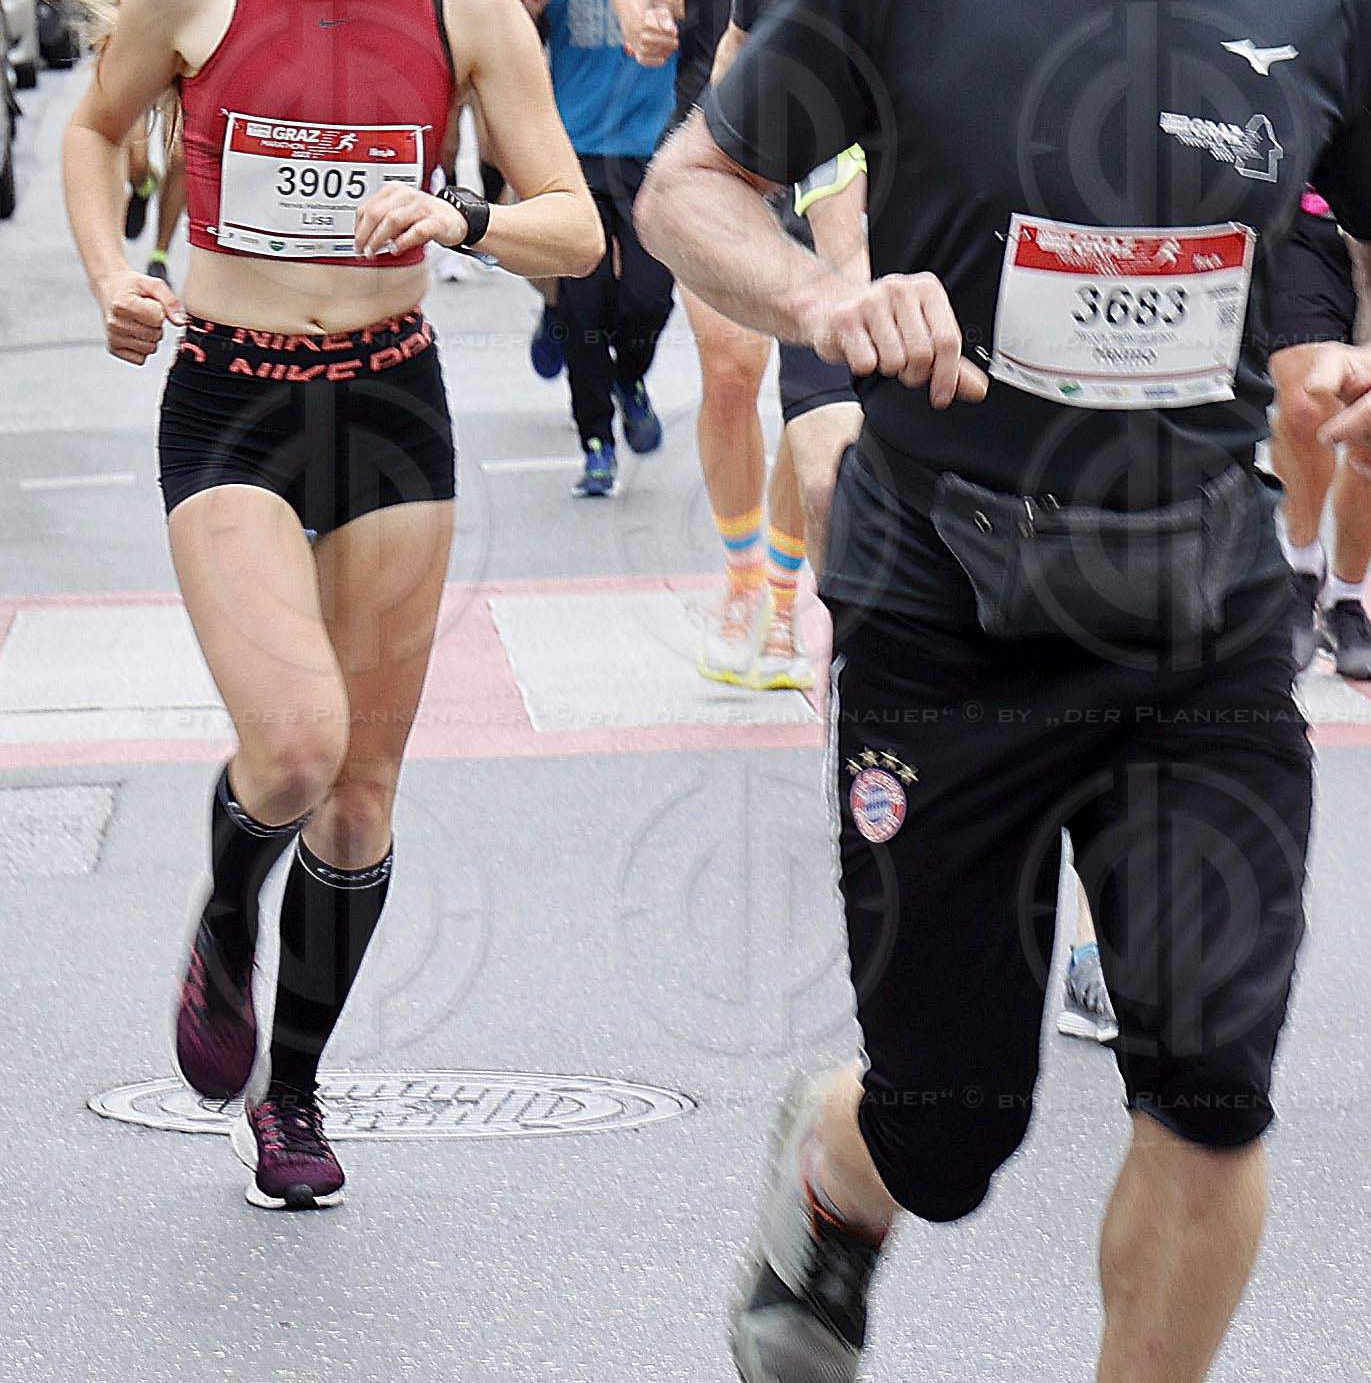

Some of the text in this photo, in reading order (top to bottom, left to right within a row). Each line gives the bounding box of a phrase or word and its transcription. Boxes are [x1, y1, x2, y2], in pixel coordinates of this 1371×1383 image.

[272, 126, 321, 143] GRAZ
[277, 166, 367, 199] 3905
[302, 212, 335, 226] Lisa
[1071, 283, 1187, 325] 3683
